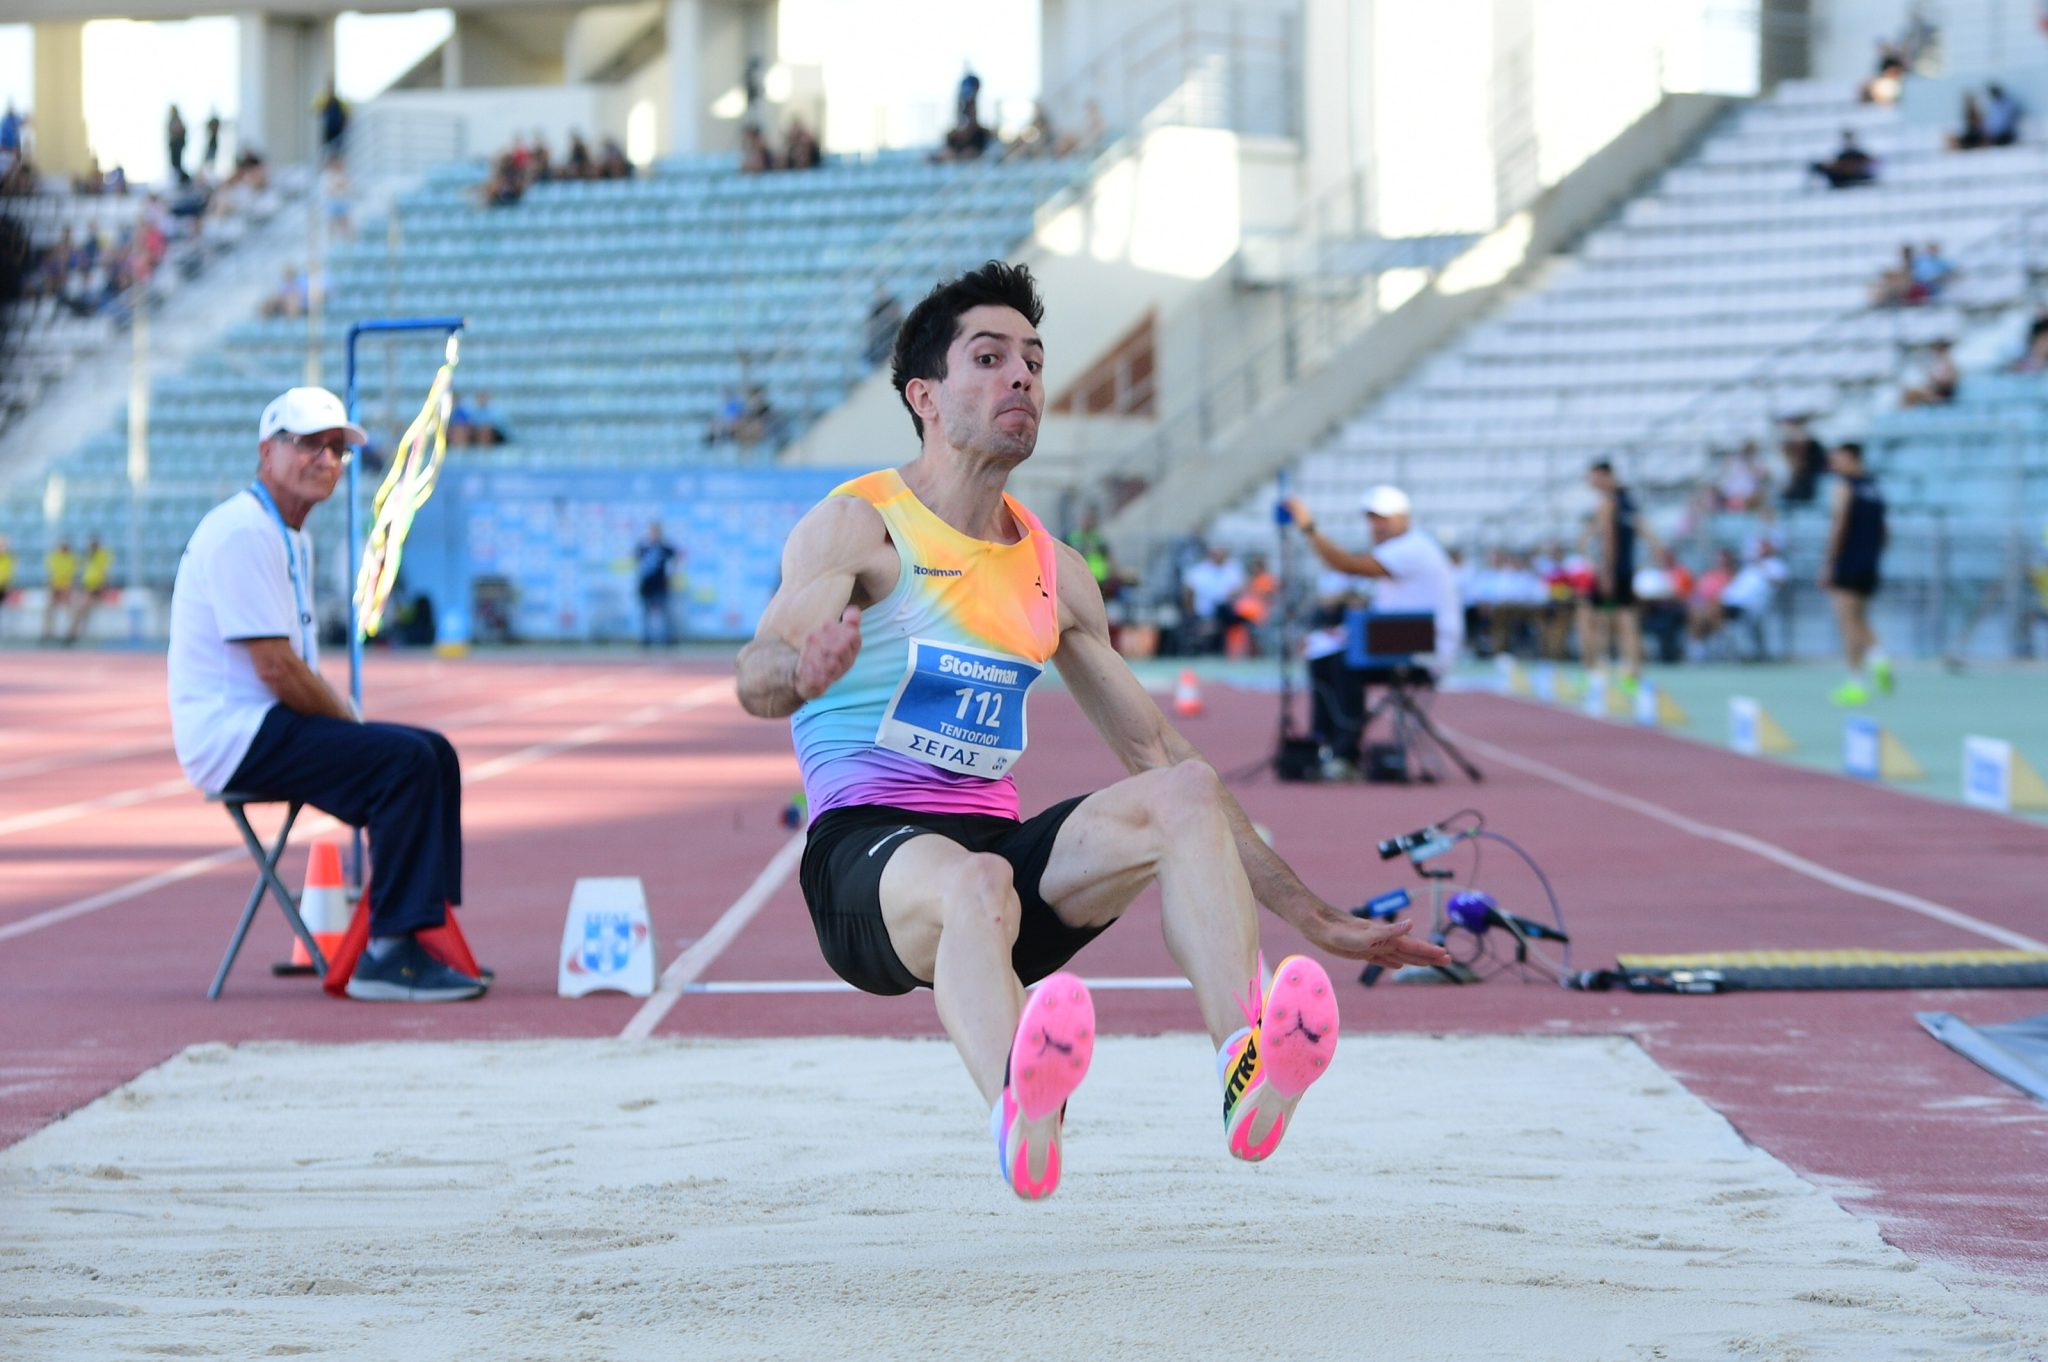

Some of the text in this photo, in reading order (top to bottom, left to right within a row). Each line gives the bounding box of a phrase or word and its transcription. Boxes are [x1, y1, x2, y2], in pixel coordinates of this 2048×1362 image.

[939, 653, 1018, 685] Stoiximan
[955, 687, 1003, 728] 112
[940, 721, 1000, 746] ΤΕΝΤΟΓΛΟΥ
[909, 734, 980, 767] ΣΕΓΑΣ
